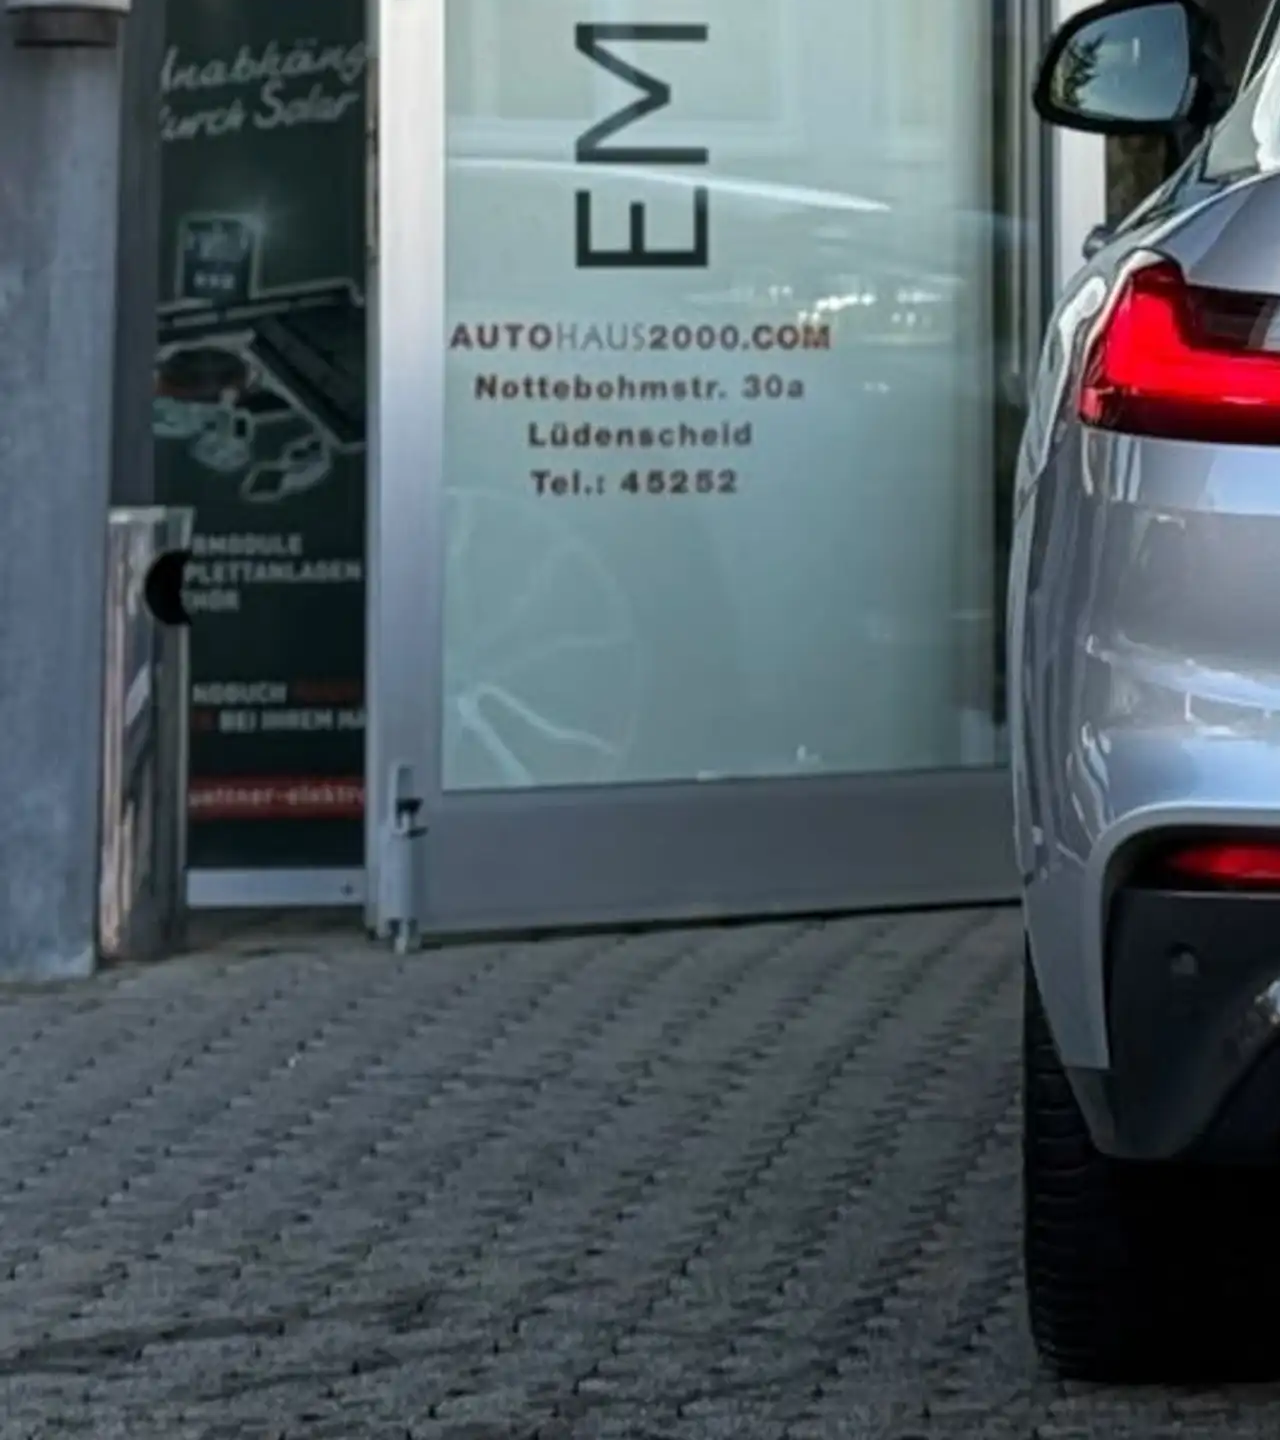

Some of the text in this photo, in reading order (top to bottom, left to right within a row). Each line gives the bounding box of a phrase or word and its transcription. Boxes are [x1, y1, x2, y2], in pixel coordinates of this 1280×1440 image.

[449, 323, 832, 351] AUTOHAUS2000.COM
[474, 374, 806, 400] Nottebohmstr. 30a
[527, 421, 753, 448] Lüdenscheid
[530, 468, 738, 496] Tel.: 45252
